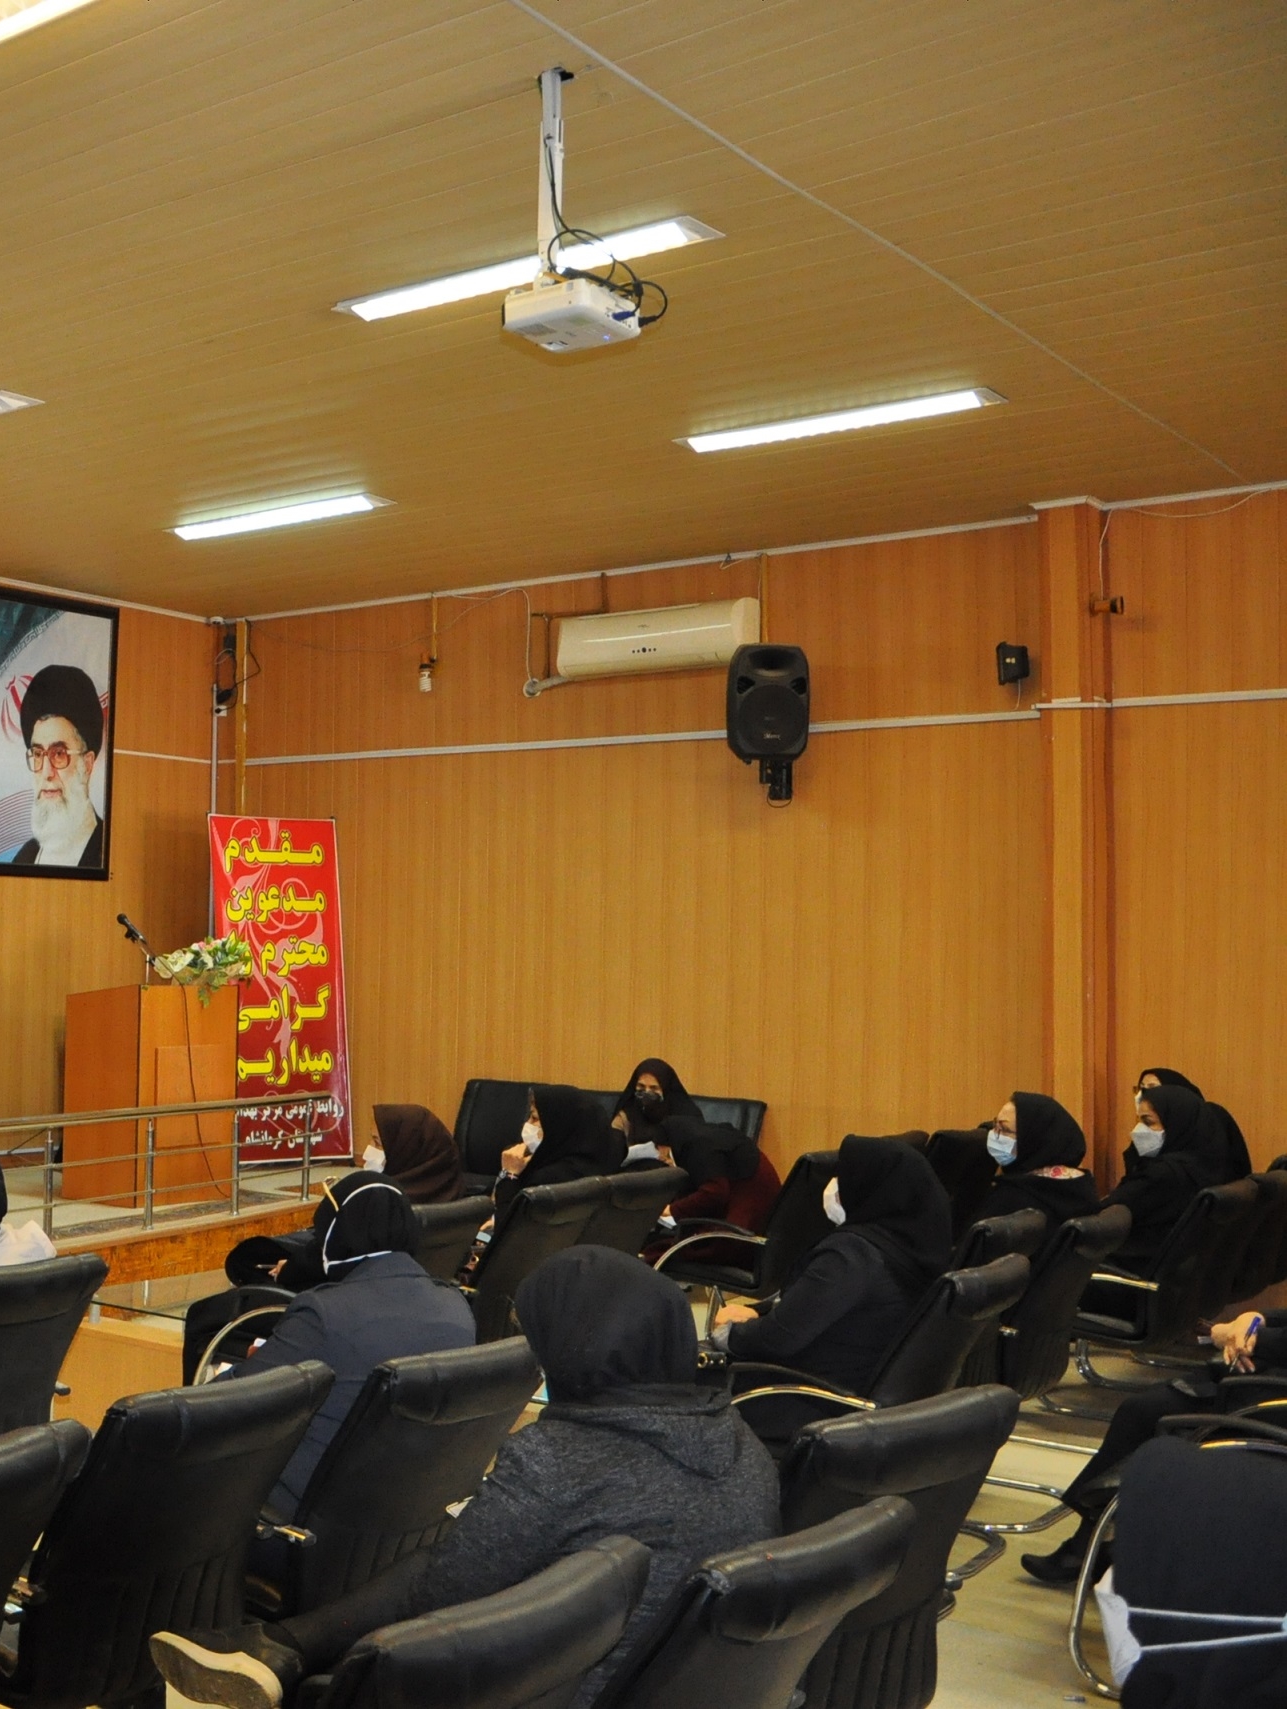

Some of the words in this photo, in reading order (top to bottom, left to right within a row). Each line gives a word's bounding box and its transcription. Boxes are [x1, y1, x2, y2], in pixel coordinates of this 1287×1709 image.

[224, 830, 323, 873] مقدم
[226, 885, 326, 922] مدعوین
[260, 935, 328, 977] محترم
[238, 984, 330, 1032] گرامی
[237, 1036, 334, 1086] میداریم
[316, 1098, 345, 1118] روابط
